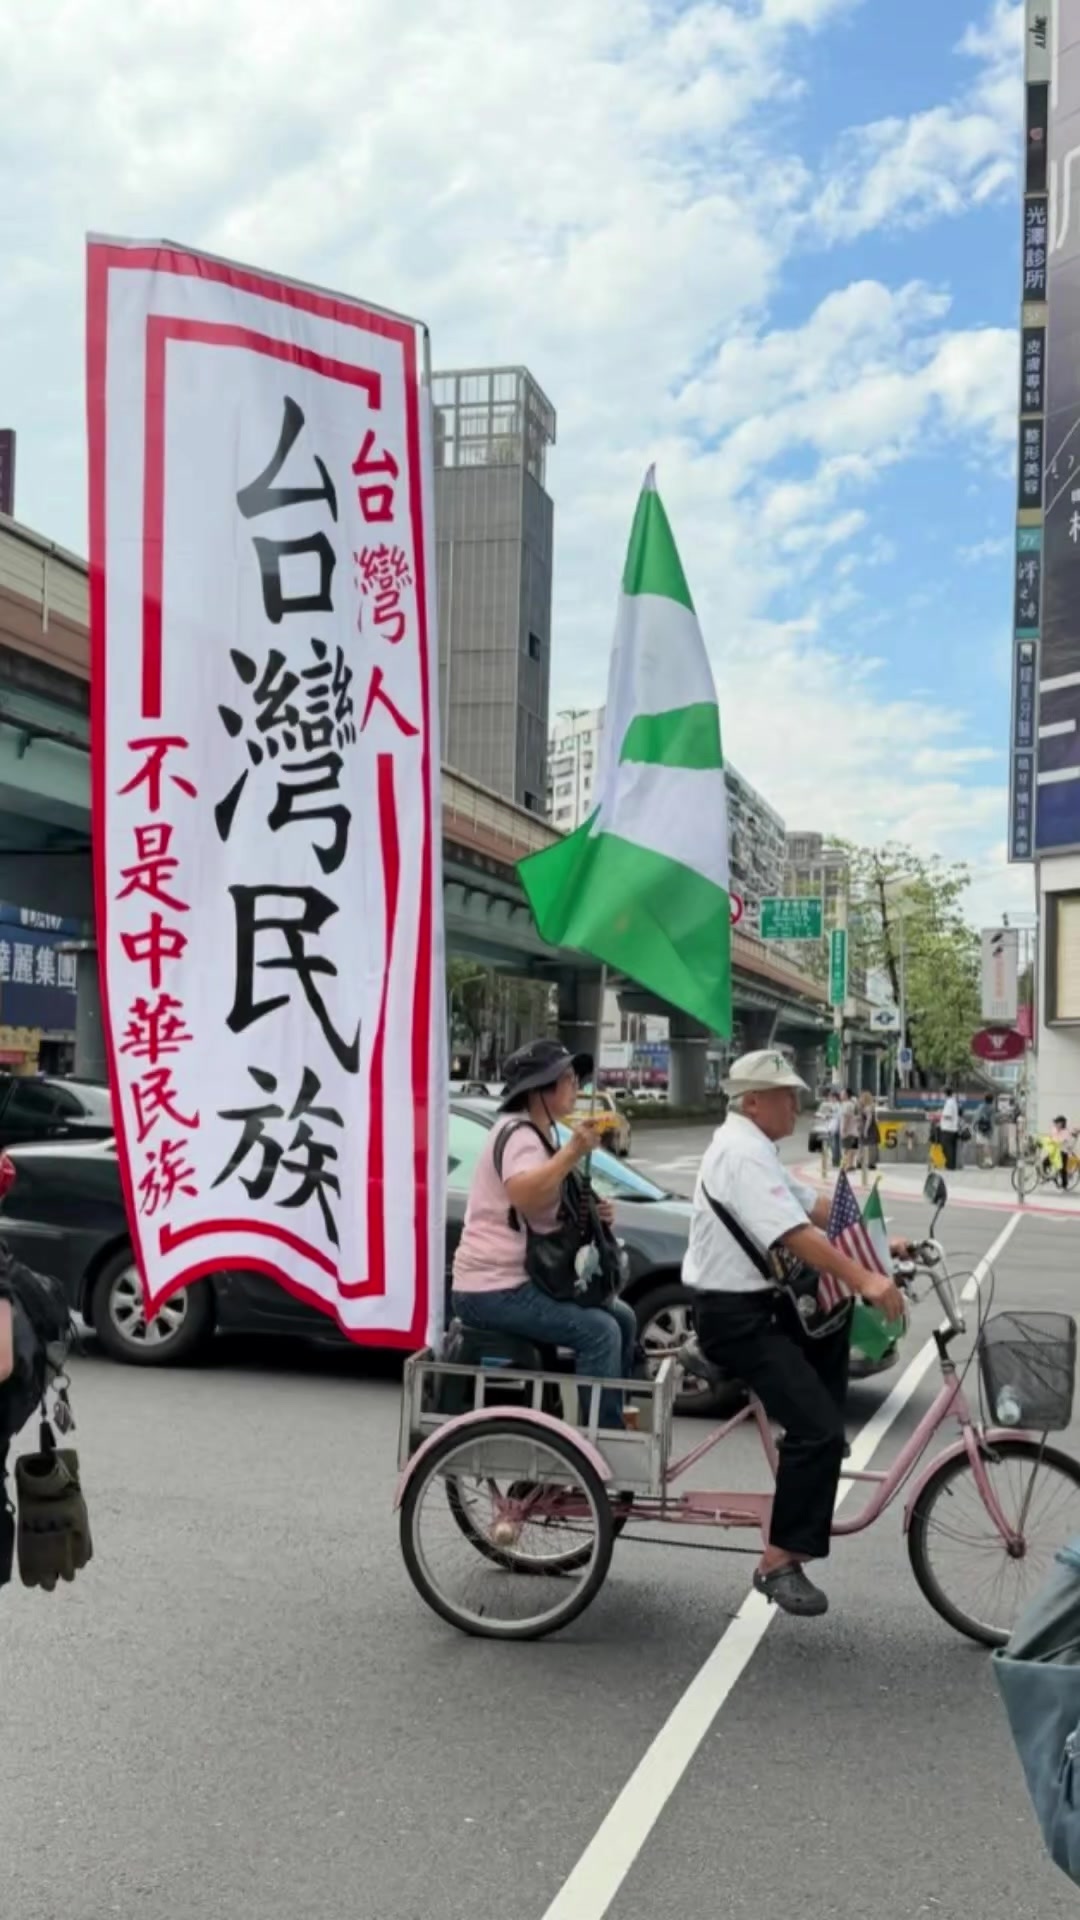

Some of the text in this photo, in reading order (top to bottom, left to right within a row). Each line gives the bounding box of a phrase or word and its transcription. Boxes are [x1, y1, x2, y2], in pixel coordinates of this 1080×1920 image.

[352, 429, 420, 737] 台灣人
[116, 736, 201, 1217] 不是中華民族
[209, 395, 362, 1251] 台灣民族
[885, 1127, 898, 1149] 5
